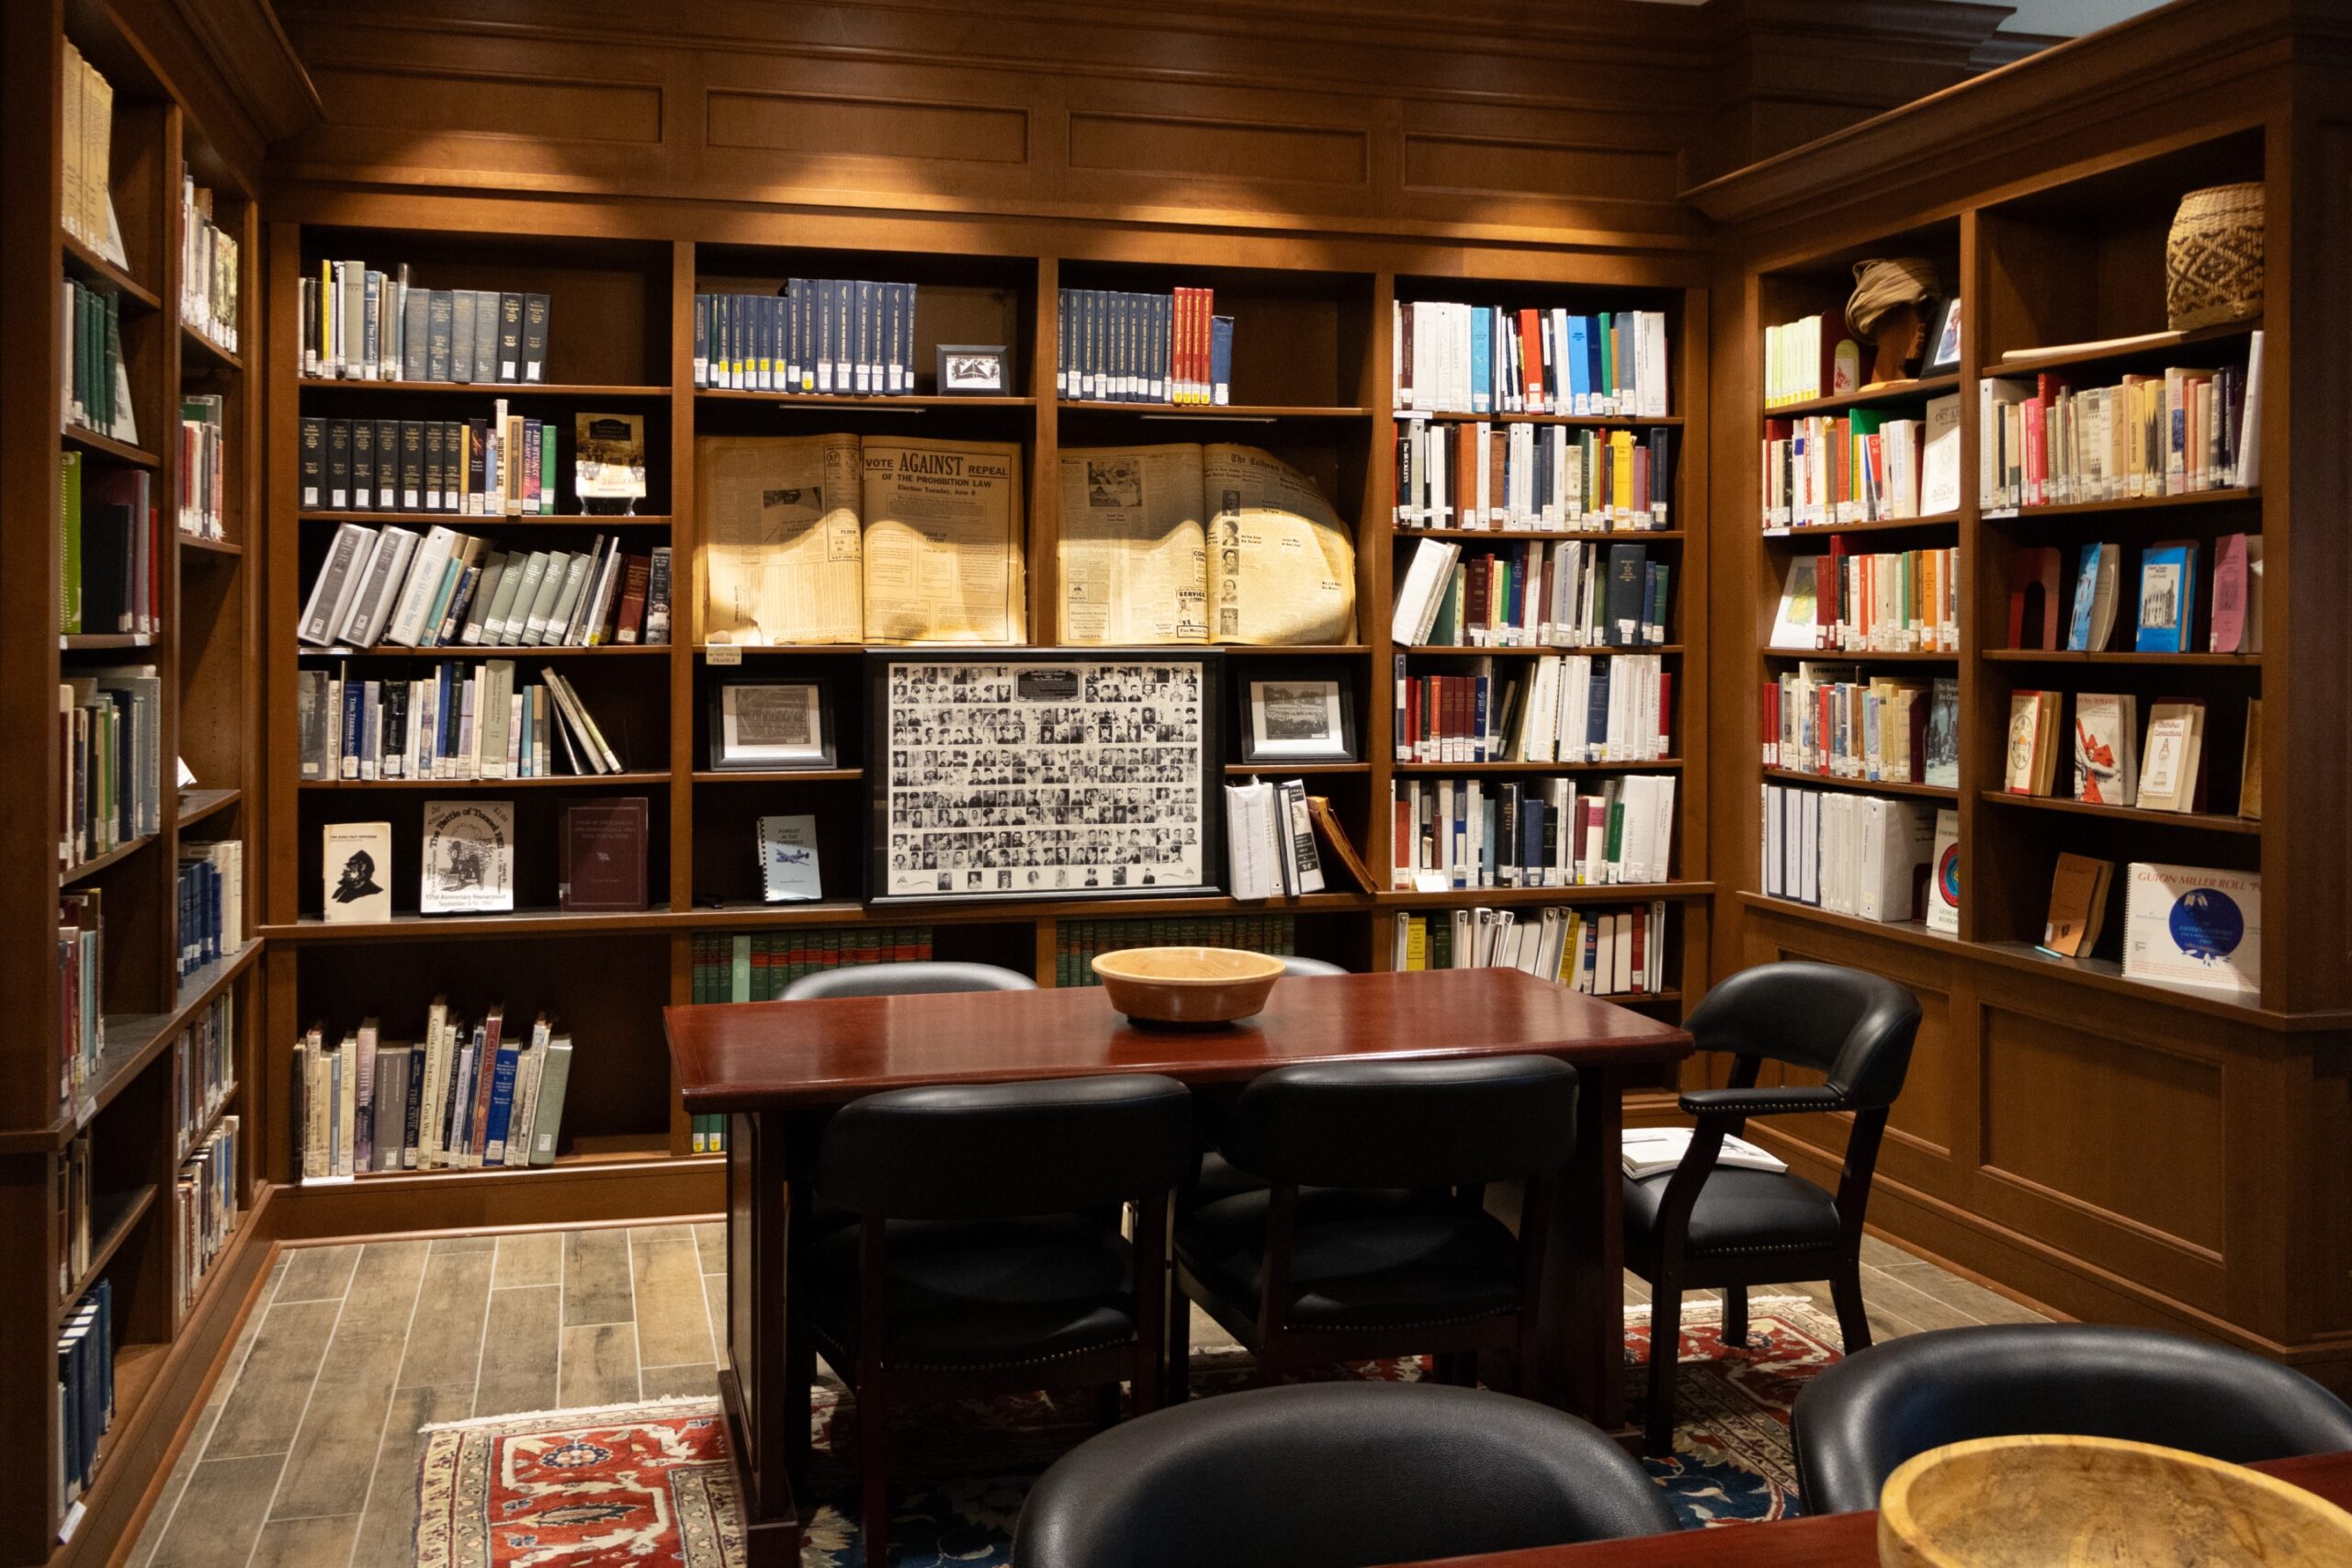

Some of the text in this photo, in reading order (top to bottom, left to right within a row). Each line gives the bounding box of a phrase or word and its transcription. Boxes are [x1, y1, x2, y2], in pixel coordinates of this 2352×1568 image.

[865, 452, 1008, 476] VOTE AGAINST REPEAL
[898, 484, 922, 492] Election
[916, 476, 969, 487] PROHIBITION
[429, 829, 441, 848] The
[436, 810, 460, 829] Battle
[473, 808, 500, 831] Tunnel
[2138, 872, 2177, 884] GUION
[2178, 876, 2216, 886] MILLER
[2219, 880, 2245, 890] ROLL
[484, 1038, 495, 1067] CIVIL
[359, 1064, 369, 1088] CIVIL
[425, 1063, 435, 1089] Soldier
[448, 1041, 460, 1103] HALLOWED GROUND
[409, 1088, 418, 1106] THE
[481, 1070, 492, 1100] WAR
[358, 1089, 369, 1108] WAR
[408, 1106, 416, 1130] CIVIL
[424, 1103, 432, 1121] Civil
[422, 1122, 430, 1137] War
